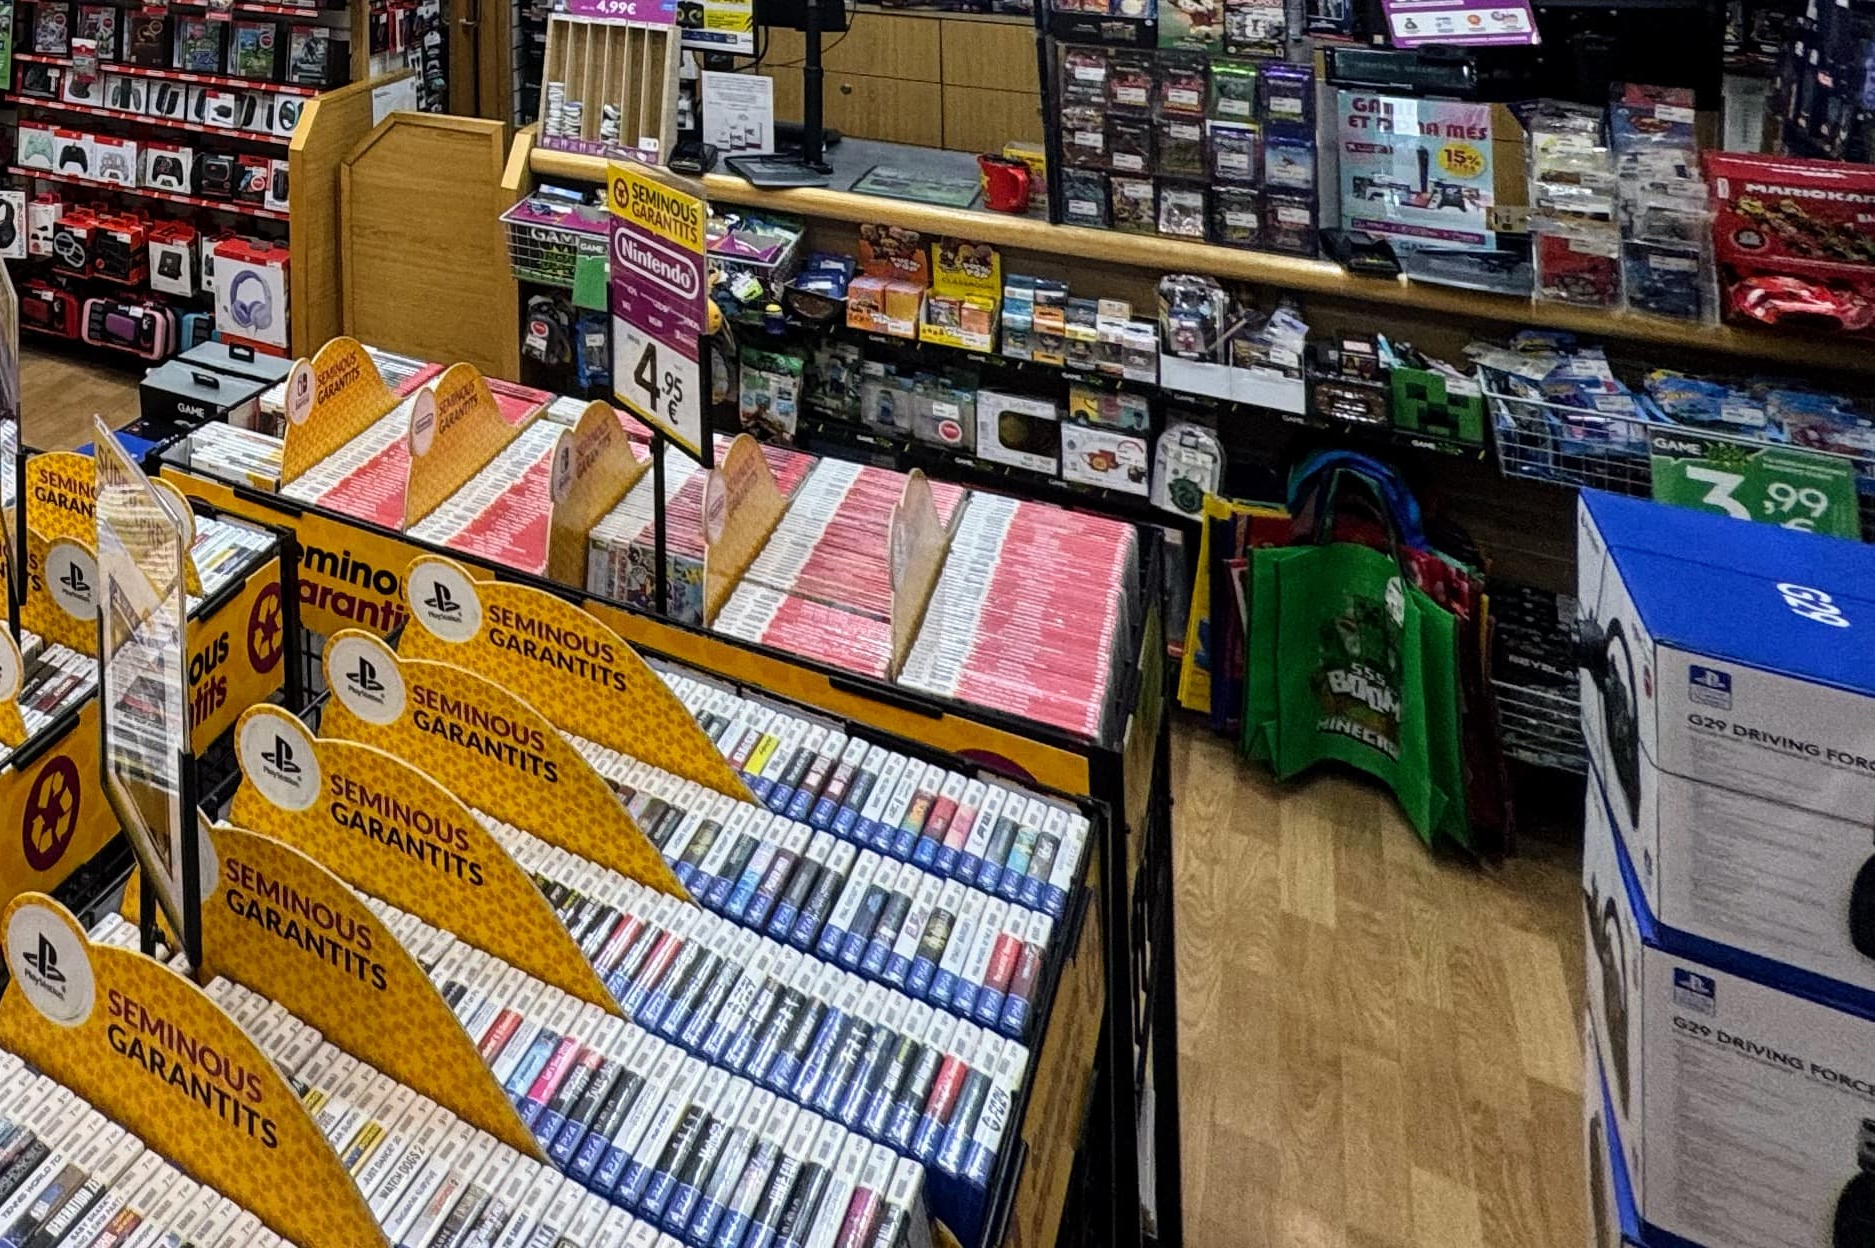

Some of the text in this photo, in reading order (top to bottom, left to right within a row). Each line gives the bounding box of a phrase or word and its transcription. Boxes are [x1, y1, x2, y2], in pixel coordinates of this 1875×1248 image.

[597, 1, 637, 15] 4,99€
[1444, 148, 1480, 166] 15%
[631, 181, 698, 224] SEMINOUS
[631, 201, 698, 243] GARANTITS
[581, 243, 604, 252] GAME
[621, 236, 693, 289] Nintendo
[316, 352, 357, 388] SEMINOUS
[317, 366, 360, 405] GARANTITS
[177, 402, 205, 418] GAME
[1654, 438, 1701, 455] GAME
[428, 610, 459, 624] PlayStation
[489, 606, 614, 663] SEMINOUS
[490, 630, 626, 692] GARANTITS
[348, 688, 383, 706] PlayStation
[413, 686, 545, 751] SEMINOUS
[413, 708, 558, 784] GARANTITS
[1688, 714, 1875, 770] G29 DRIVING FORC
[263, 771, 301, 790] PlayStation
[330, 774, 469, 852] SEMINOUS
[331, 802, 484, 887] GARANTITS
[226, 856, 372, 952] SEMINOUS
[227, 888, 387, 991] GARANTITS
[24, 970, 66, 1001] PlayStation
[108, 989, 263, 1103] SEMINOUS
[1672, 1016, 1712, 1035] G29
[1718, 1031, 1805, 1070] DRIVING
[108, 1024, 279, 1150] GARANTITS
[363, 1143, 397, 1186] JUST DANCE
[379, 1149, 420, 1201] WATCH DOGS
